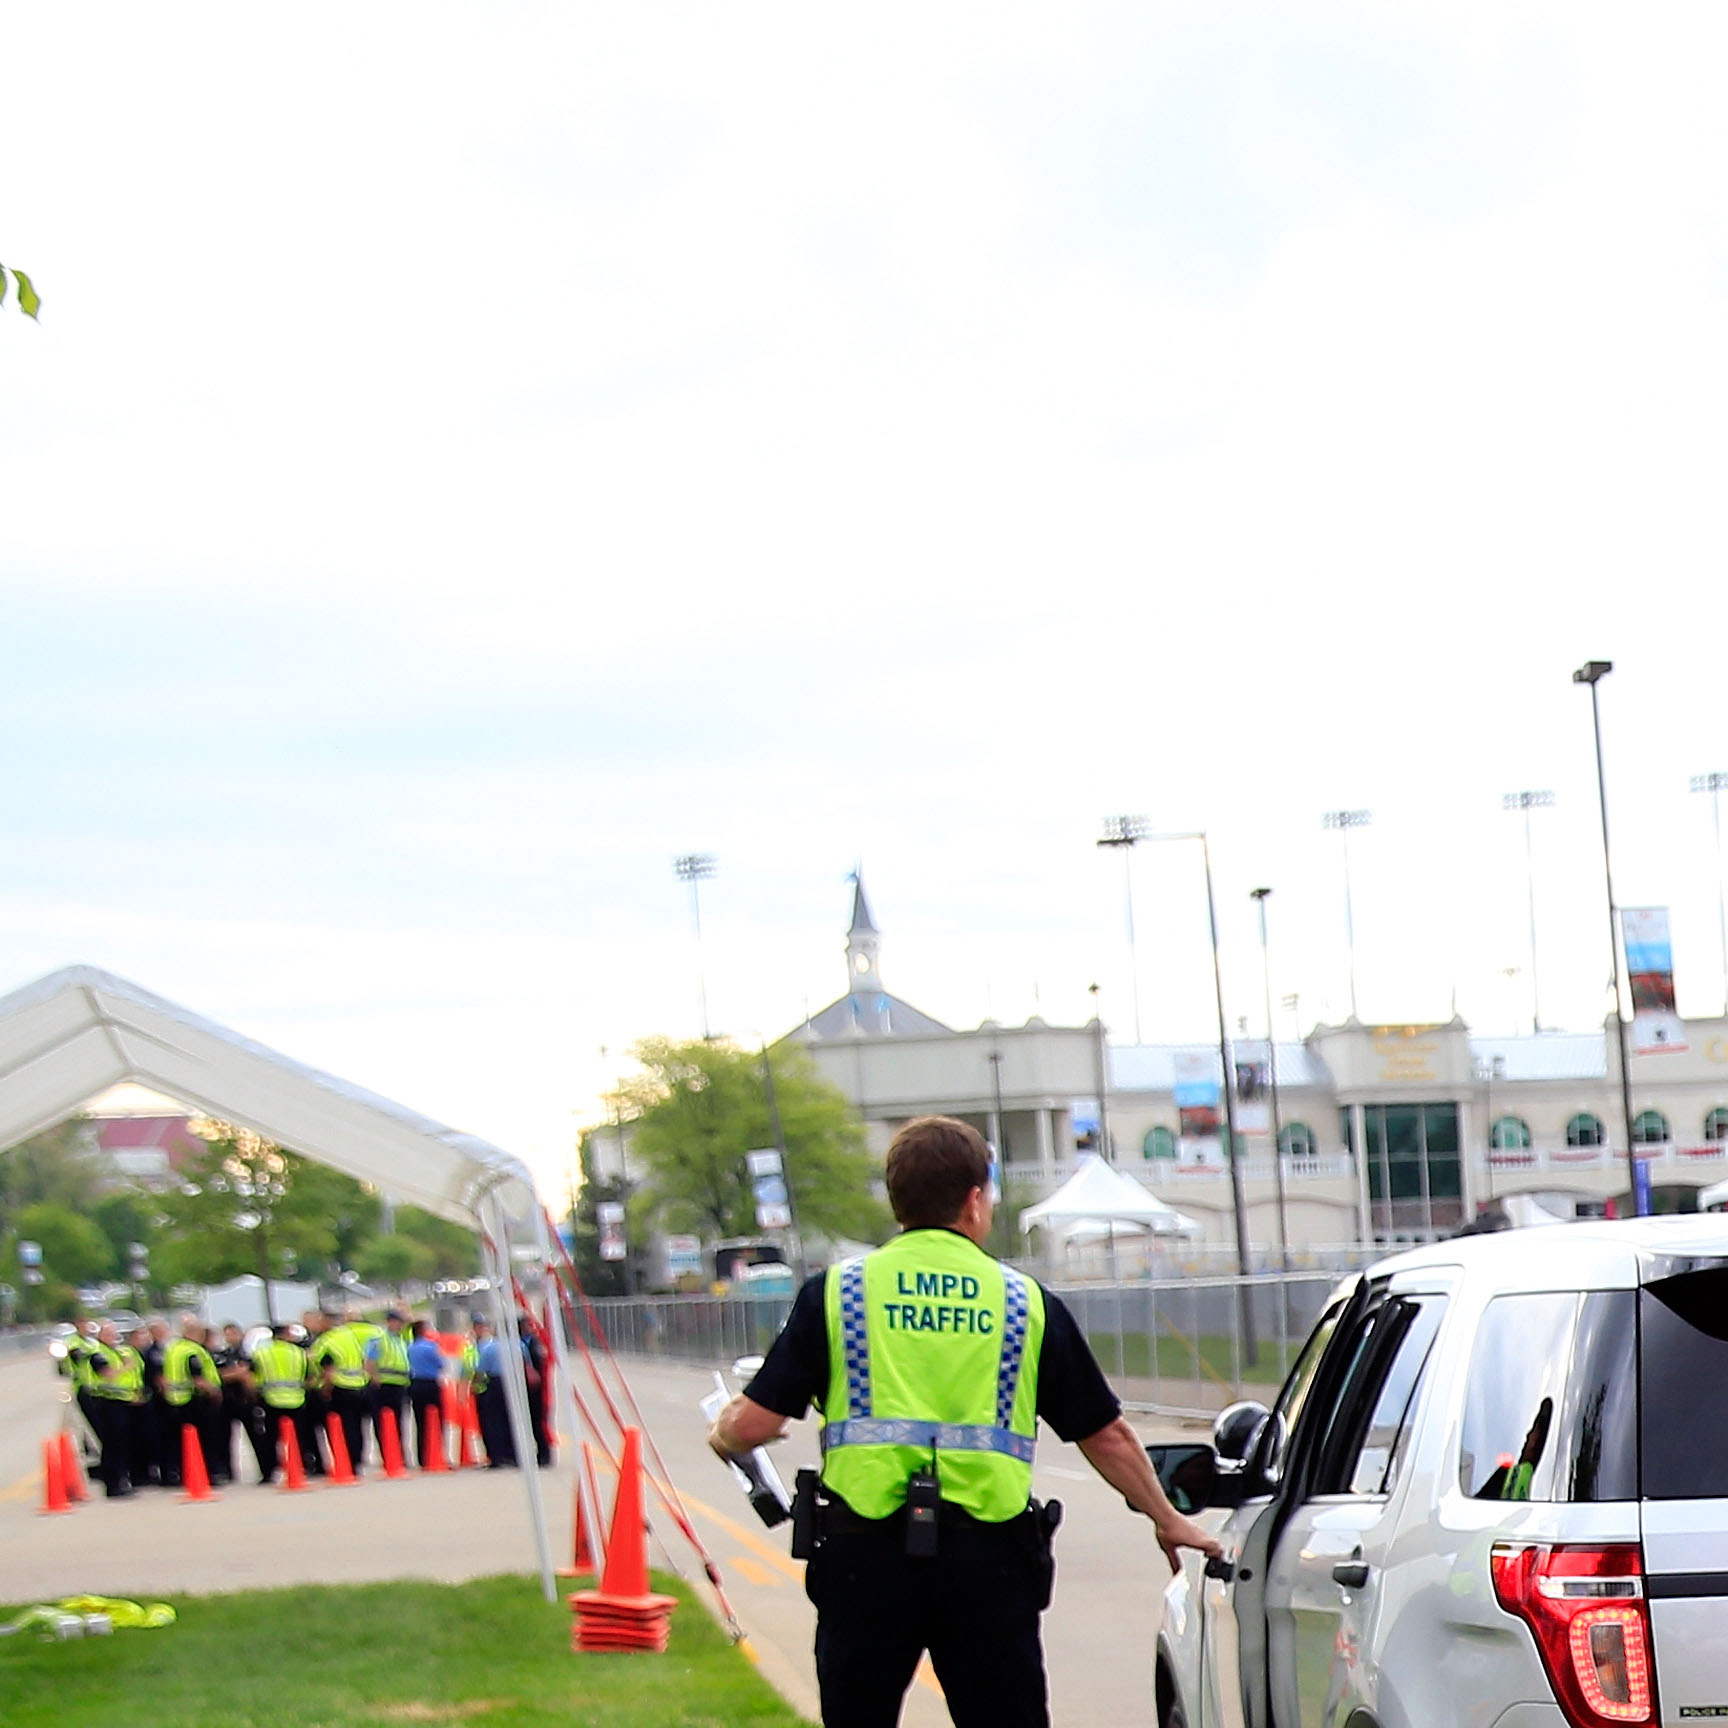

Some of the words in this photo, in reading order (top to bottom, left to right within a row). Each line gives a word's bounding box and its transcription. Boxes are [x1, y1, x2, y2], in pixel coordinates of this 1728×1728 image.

[898, 1272, 980, 1299] LMPD
[884, 1304, 994, 1334] TRAFFIC
[1683, 1707, 1716, 1716] POLICE
